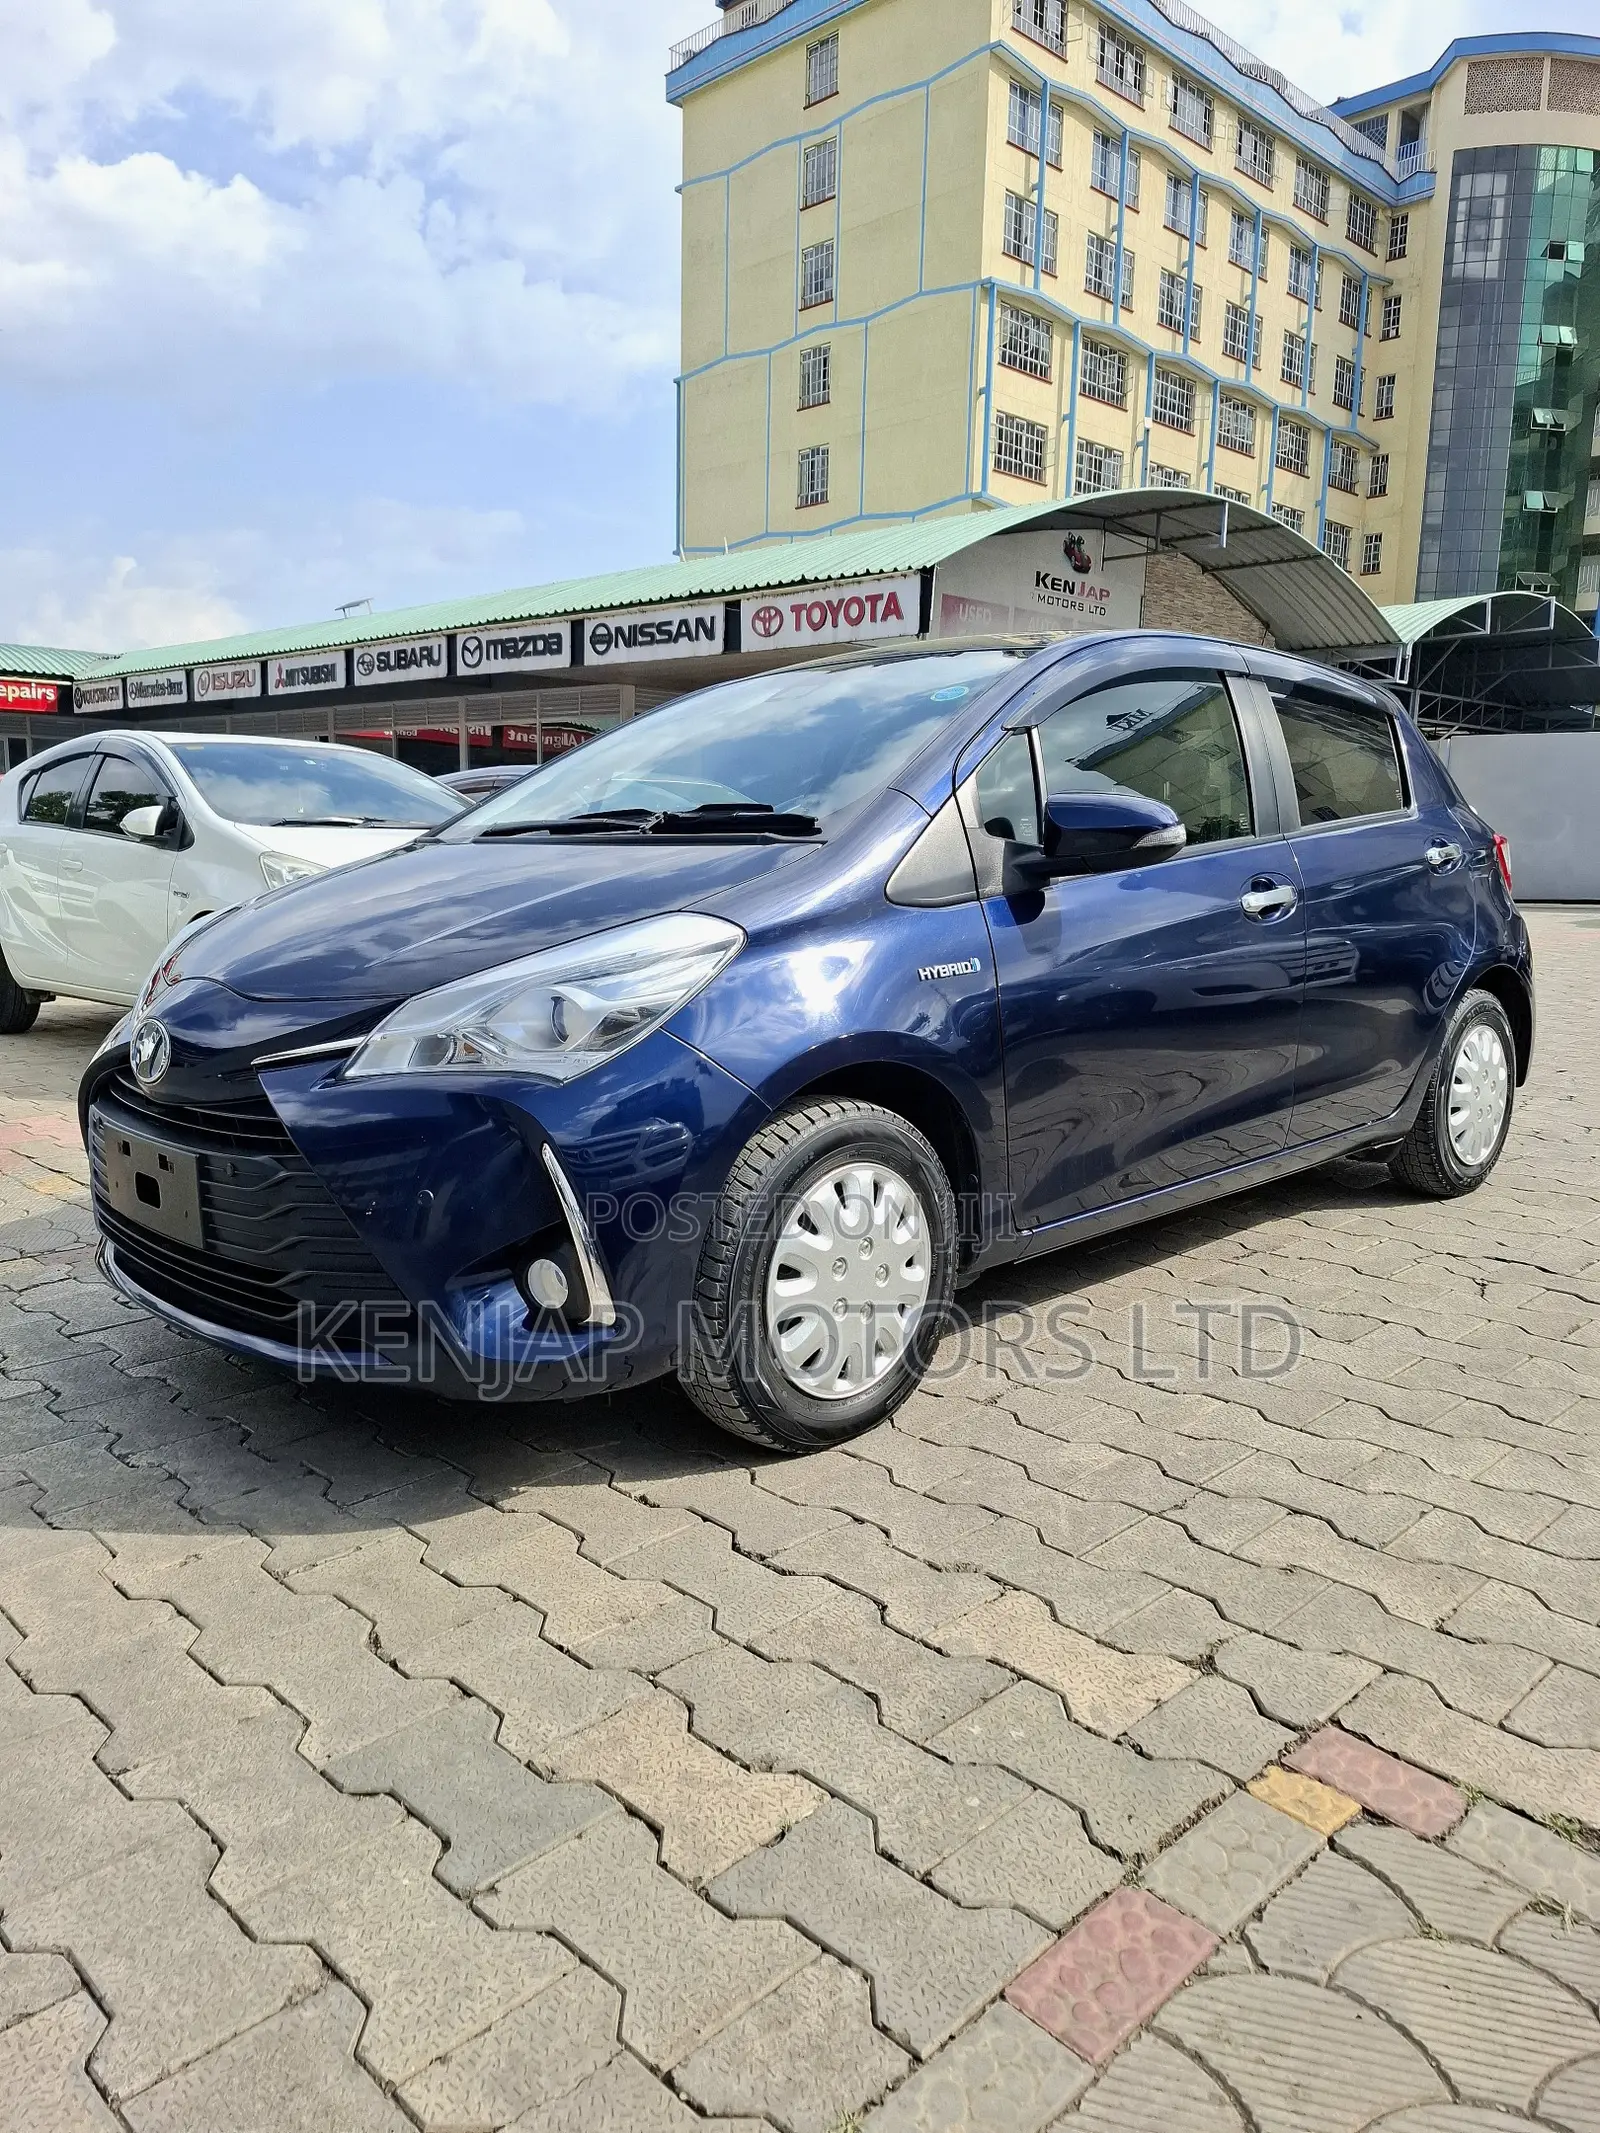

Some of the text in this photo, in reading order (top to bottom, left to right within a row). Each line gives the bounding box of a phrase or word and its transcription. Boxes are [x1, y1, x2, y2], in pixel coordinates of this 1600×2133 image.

[790, 591, 904, 632] TOYOTA
[1037, 593, 1107, 616] MOTORS LTD
[614, 615, 716, 649] NISSAN
[376, 643, 442, 673] SUBARU
[211, 668, 256, 691] ISUZU
[285, 663, 337, 687] MITSUBISHI
[917, 961, 972, 981] HYBRID
